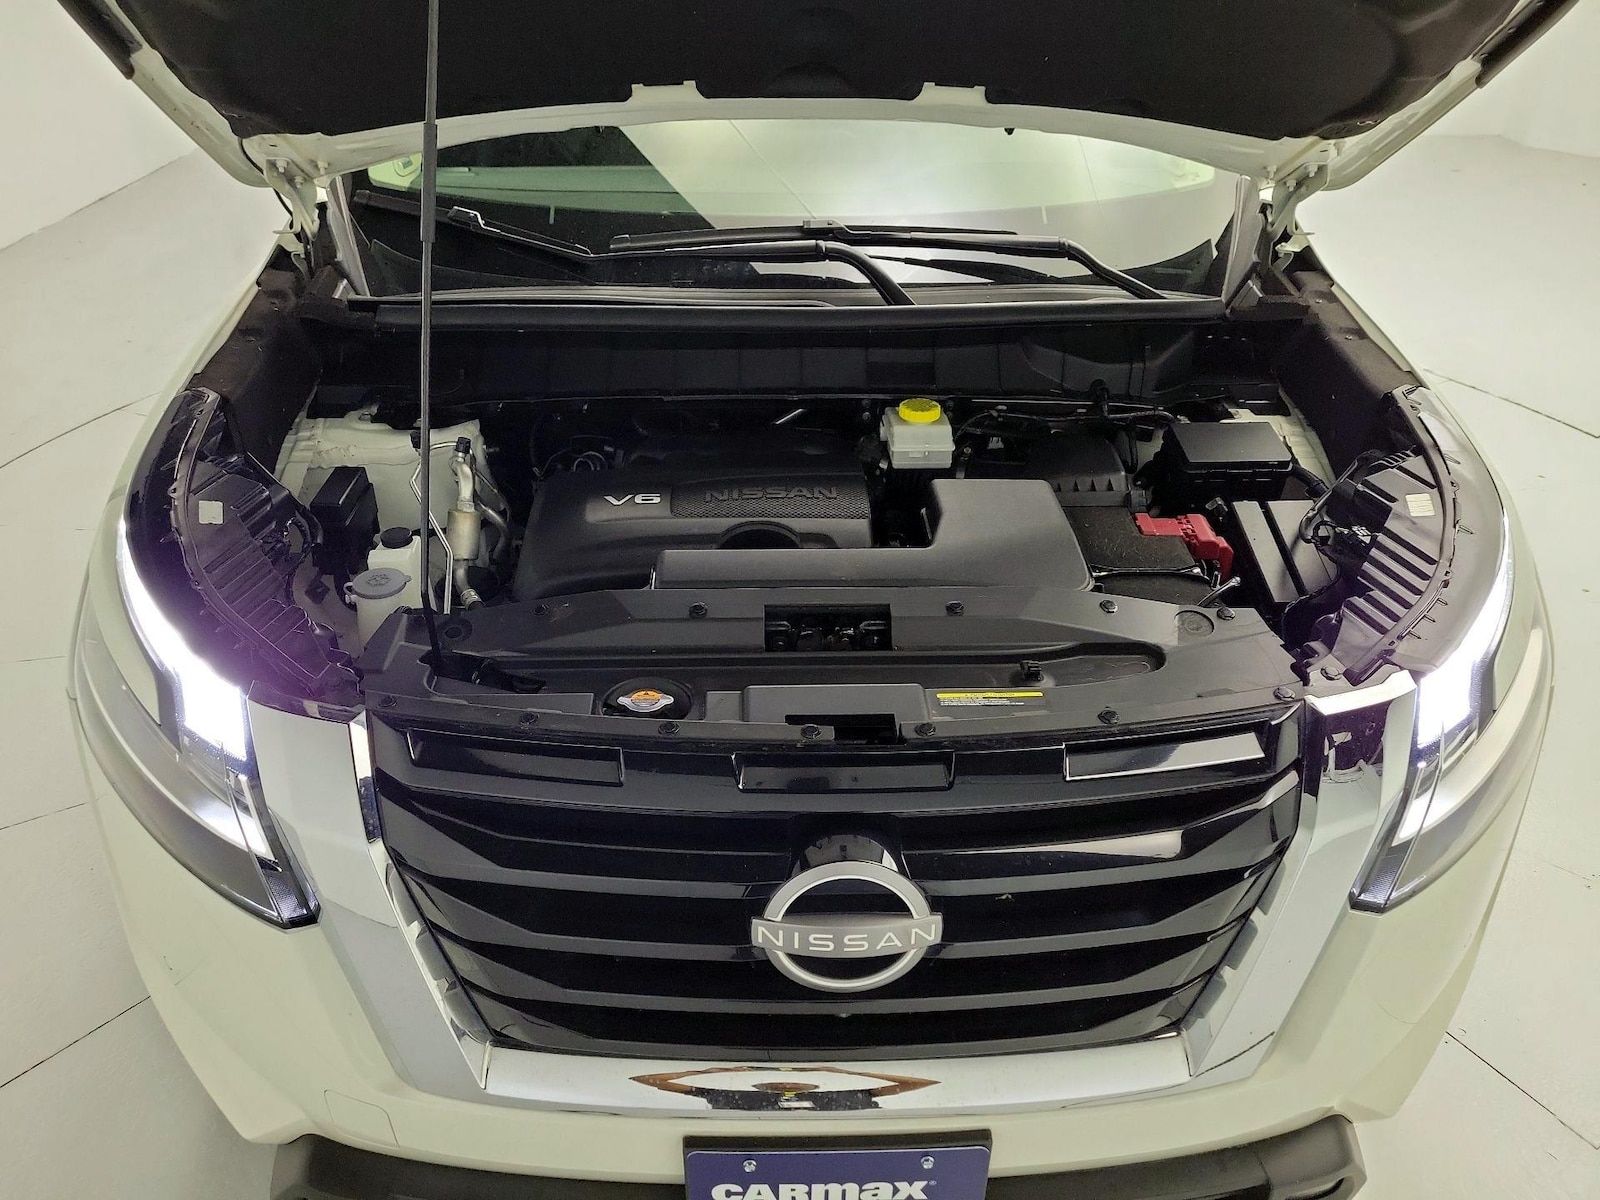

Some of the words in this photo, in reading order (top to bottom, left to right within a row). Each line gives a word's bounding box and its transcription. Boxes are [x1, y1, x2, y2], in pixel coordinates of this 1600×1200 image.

[603, 493, 661, 506] V6
[705, 486, 838, 501] NISSAN
[757, 924, 936, 951] NISSAN
